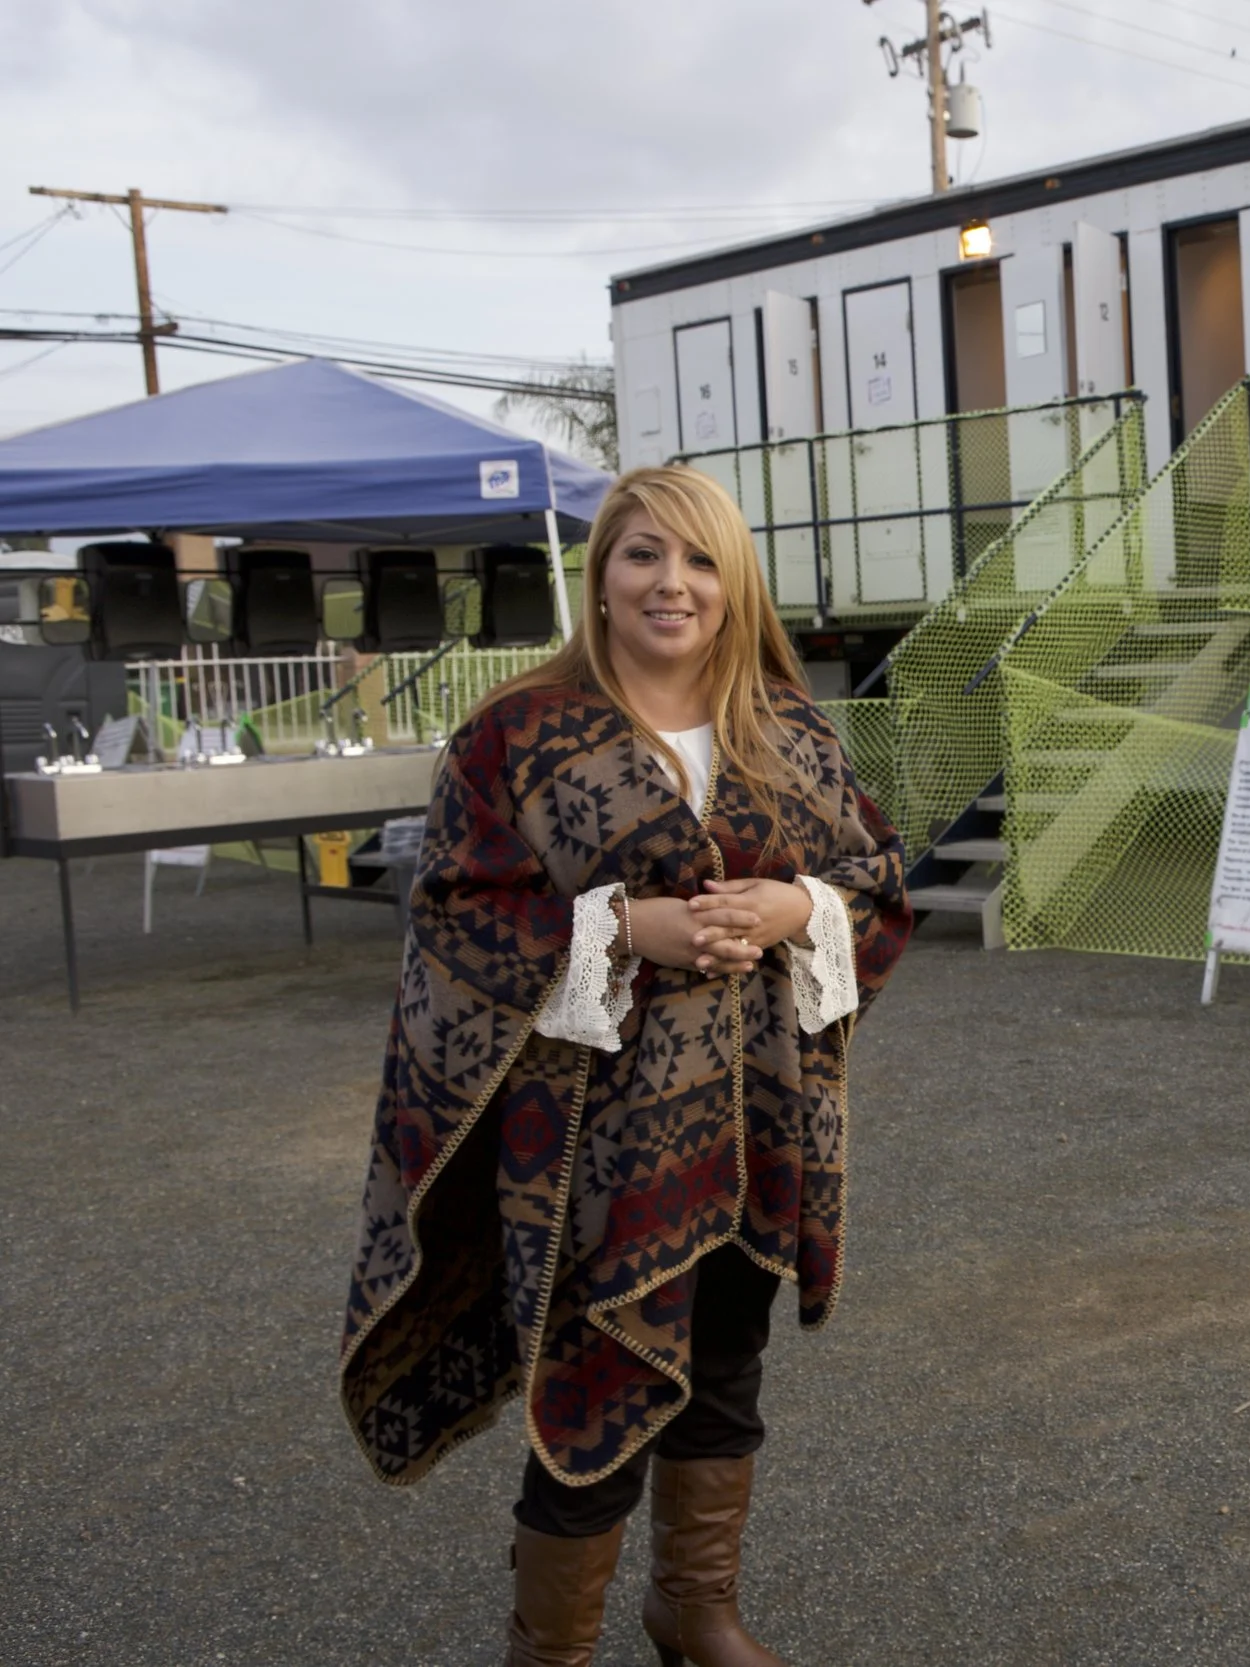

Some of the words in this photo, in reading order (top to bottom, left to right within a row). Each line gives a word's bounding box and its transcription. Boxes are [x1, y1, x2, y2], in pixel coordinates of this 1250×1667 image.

[1099, 302, 1109, 322] 12
[788, 358, 799, 376] 15
[873, 352, 887, 369] 14
[700, 383, 711, 400] 16
